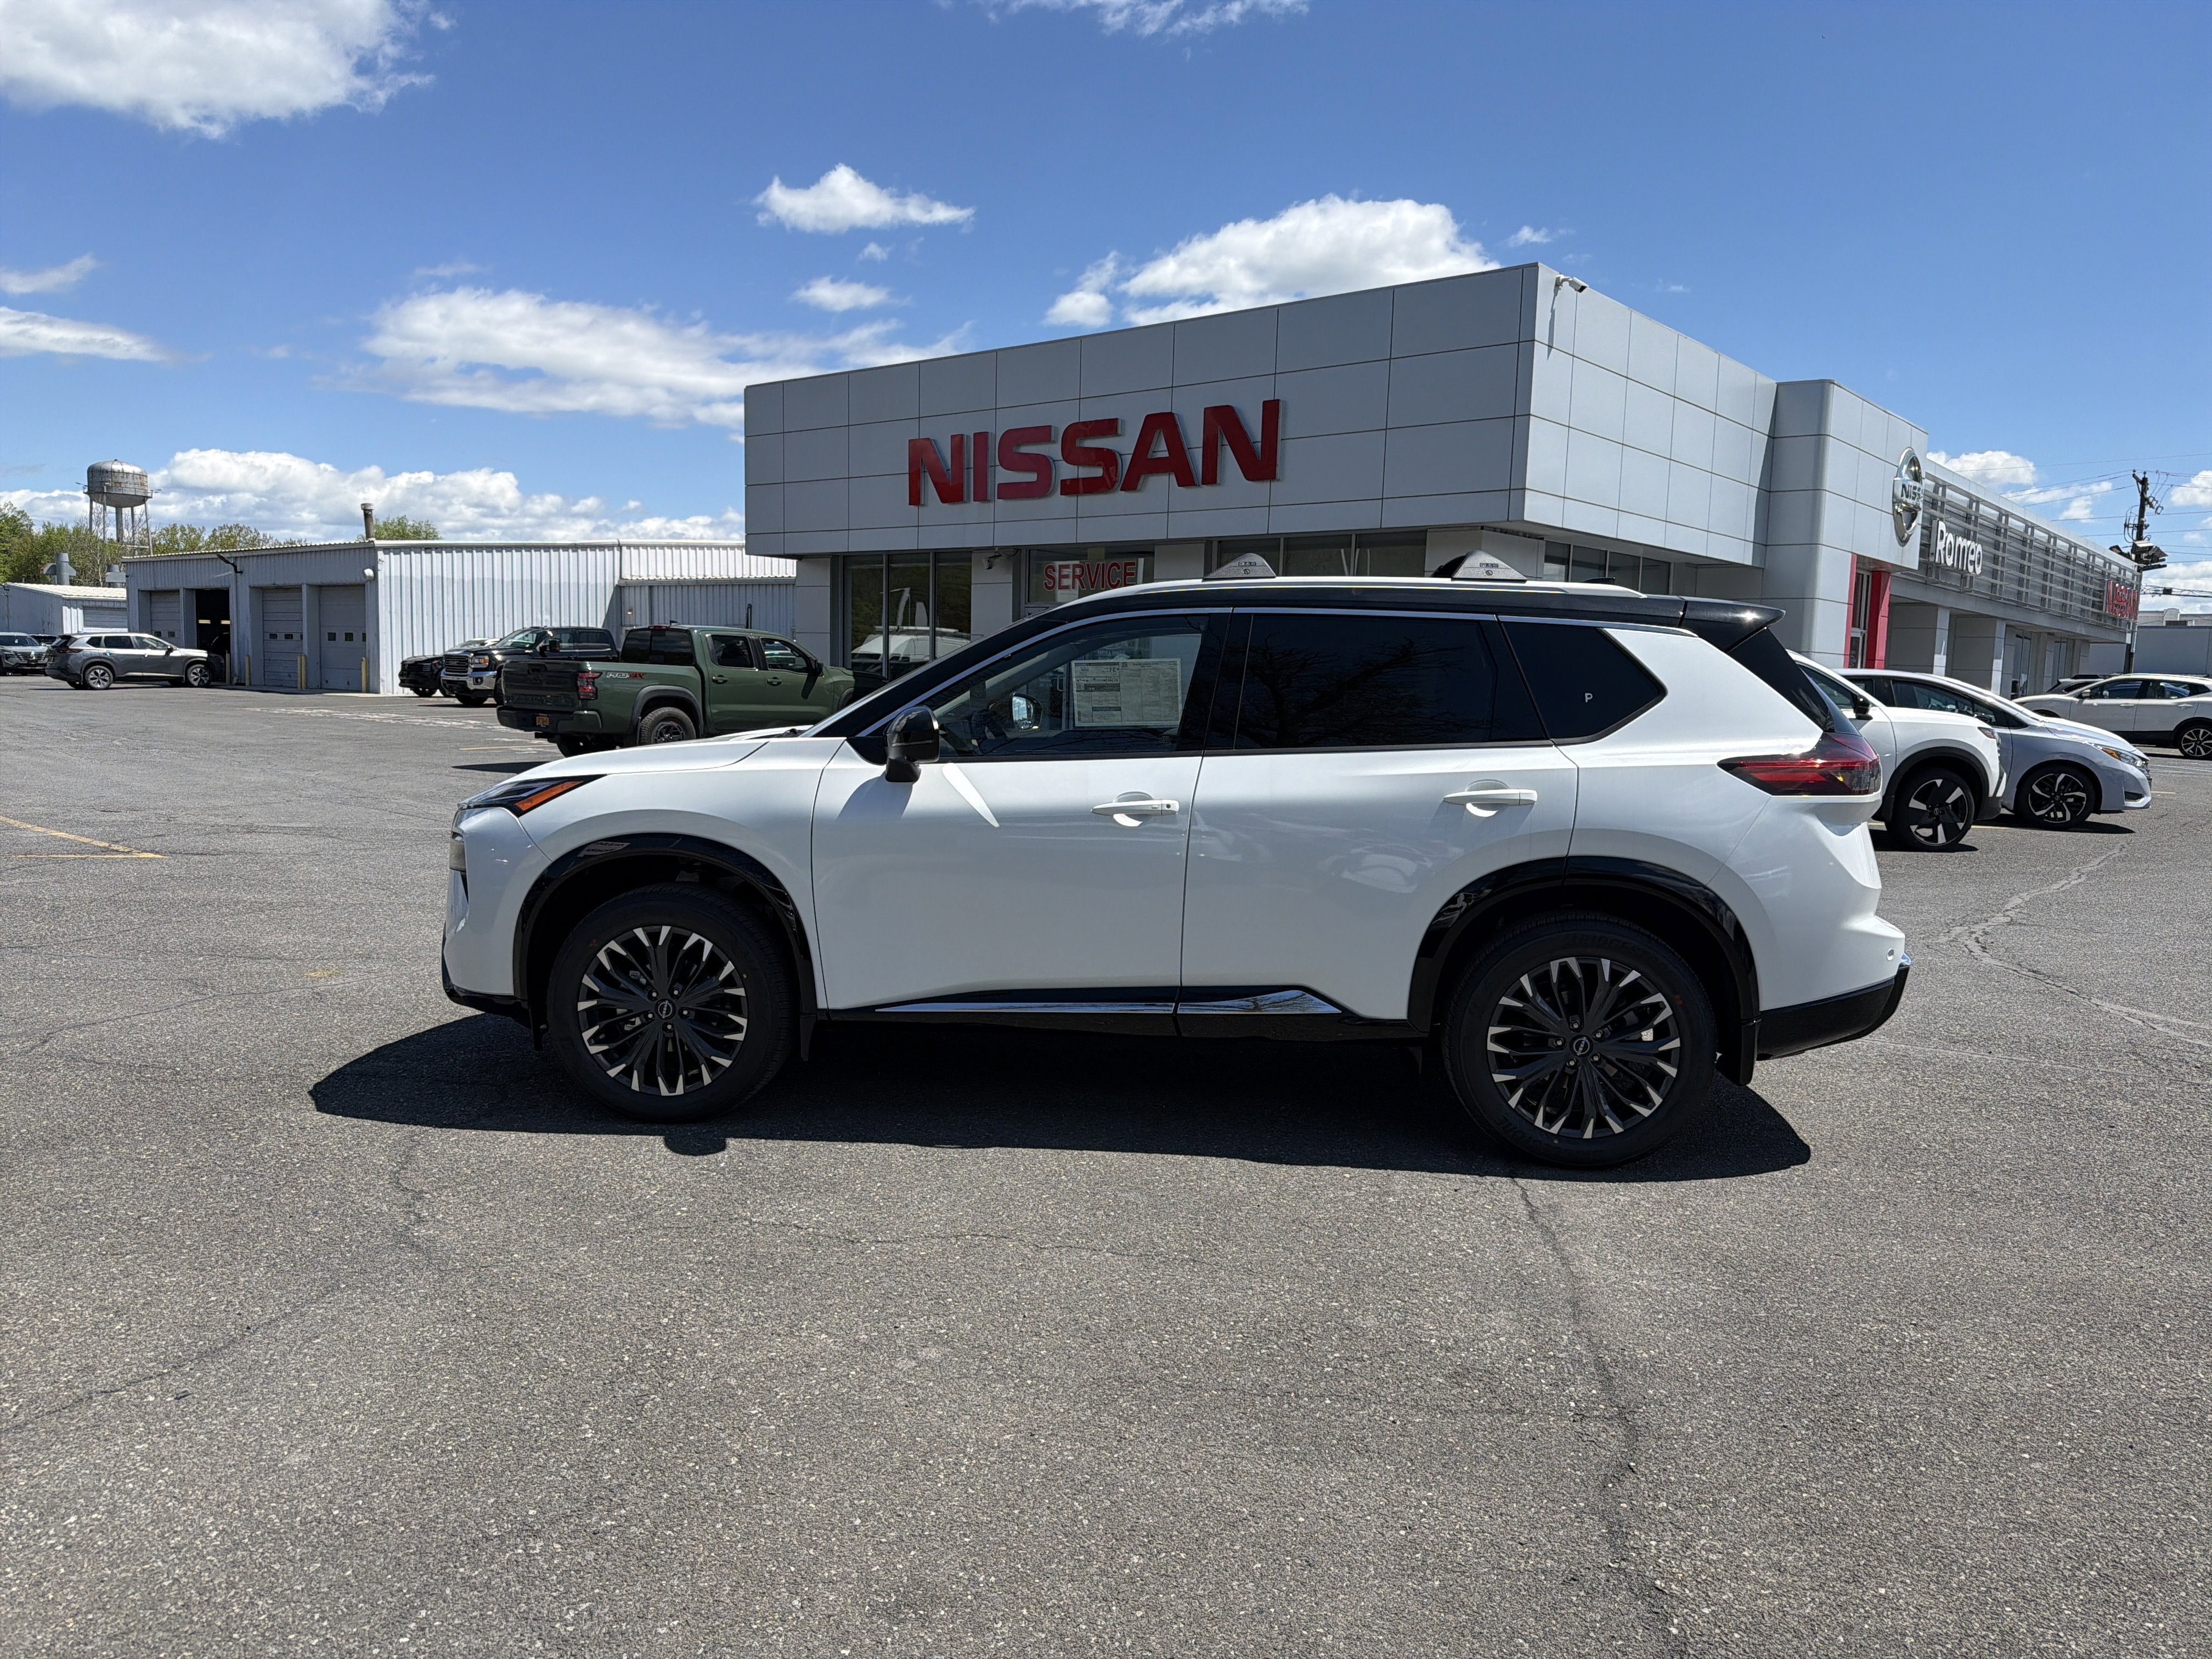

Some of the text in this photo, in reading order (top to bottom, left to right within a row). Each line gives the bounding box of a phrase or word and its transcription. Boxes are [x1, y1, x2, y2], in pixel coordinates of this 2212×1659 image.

[909, 399, 1281, 506] NISSAN
[1901, 483, 1923, 503] NISS
[1934, 521, 1983, 575] Romeo
[1043, 561, 1137, 591] SERVICE
[1585, 693, 1593, 703] P
